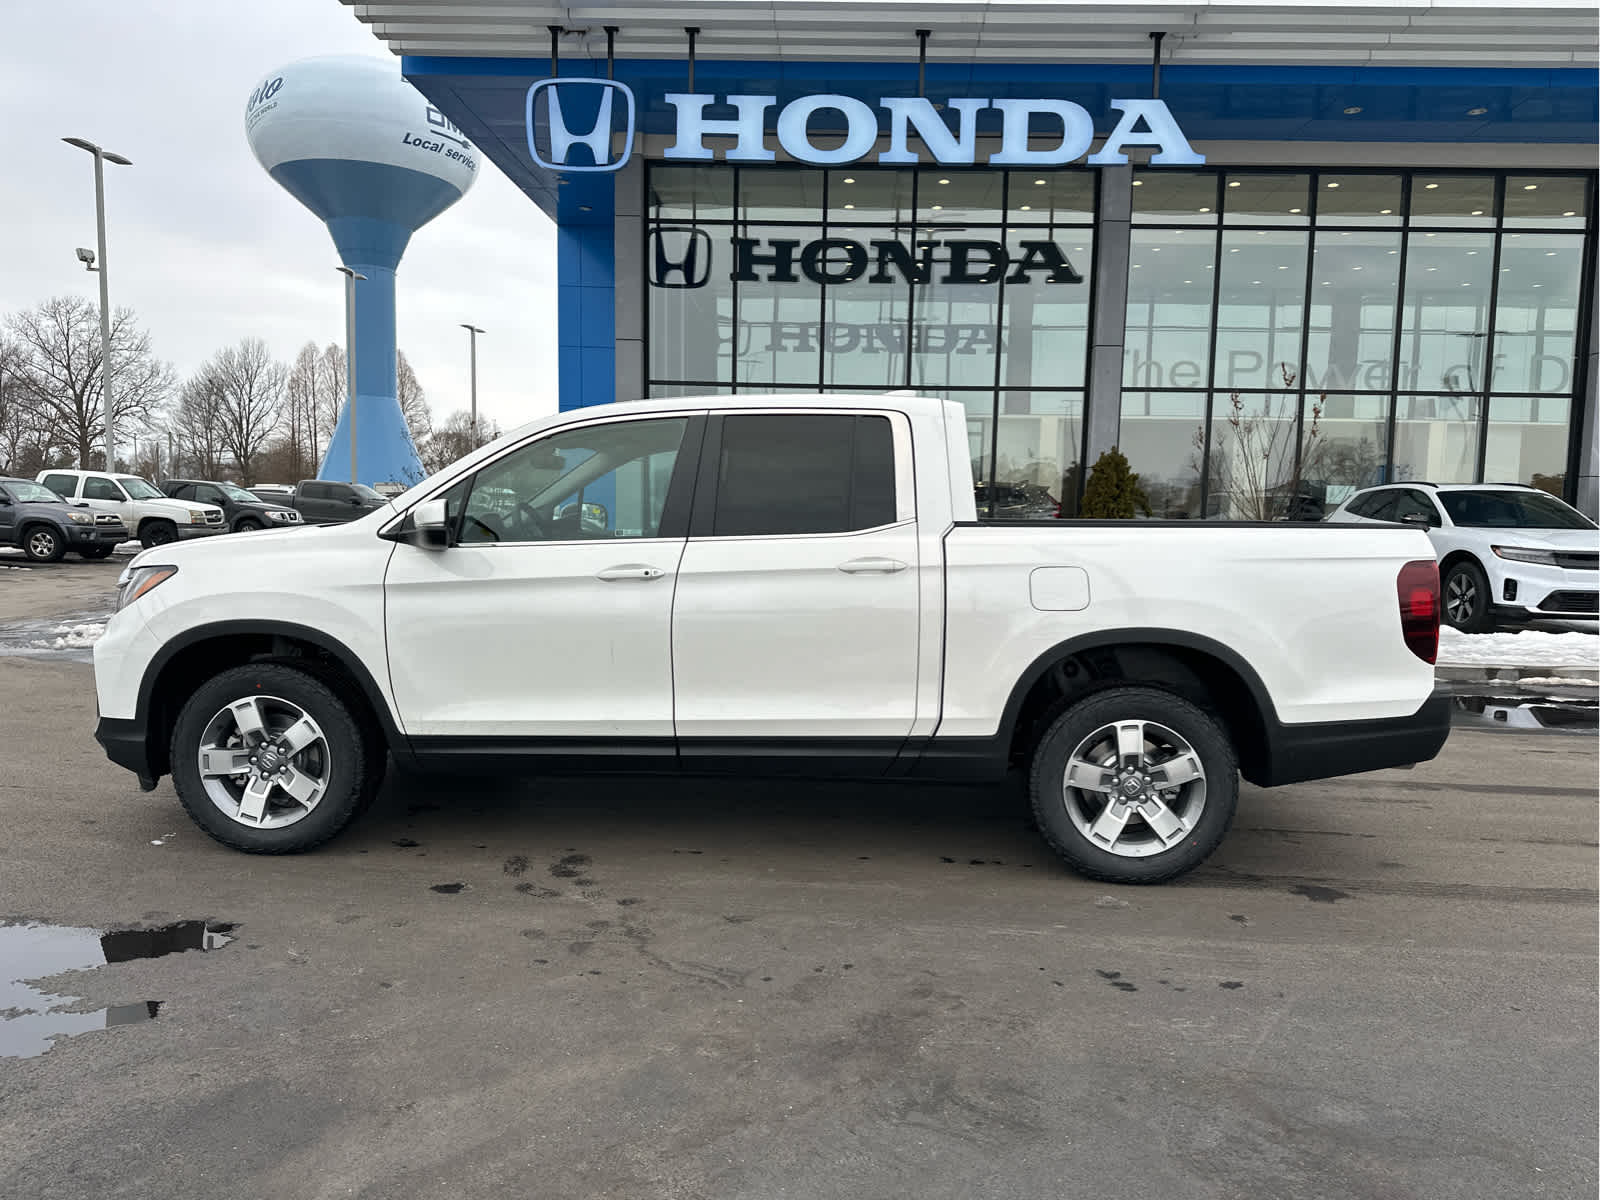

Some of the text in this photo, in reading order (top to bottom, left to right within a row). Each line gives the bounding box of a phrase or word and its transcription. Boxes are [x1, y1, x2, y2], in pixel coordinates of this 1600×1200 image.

[663, 92, 1207, 166] HONDA
[402, 132, 477, 171] Local service
[730, 237, 1084, 285] HONDA
[764, 323, 1008, 355] HONDA
[1125, 348, 1201, 387] he
